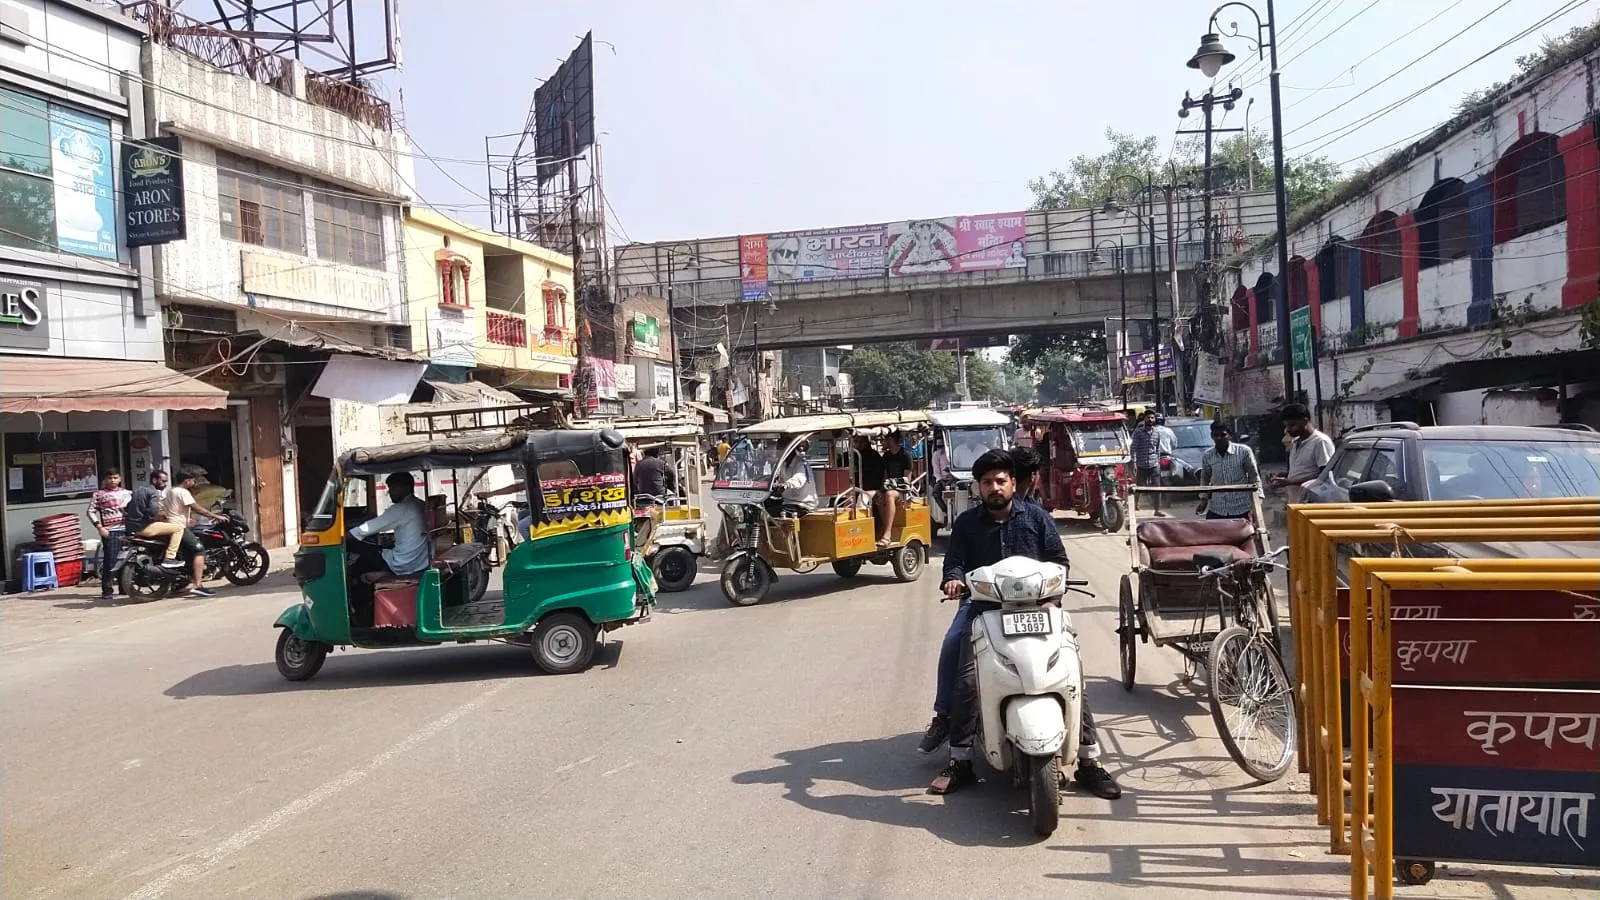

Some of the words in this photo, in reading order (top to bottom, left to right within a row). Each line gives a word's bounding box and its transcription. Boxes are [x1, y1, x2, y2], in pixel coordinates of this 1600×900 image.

[134, 155, 166, 168] ARON'S
[129, 180, 144, 188] Food
[145, 178, 174, 187] Products
[134, 188, 171, 206] ARON
[128, 207, 181, 226] STORES
[806, 231, 884, 252] भारत
[1013, 614, 1045, 624] UP25B
[1015, 623, 1045, 633] L3097
[1396, 639, 1479, 672] कृपया
[1463, 710, 1600, 756] कृपय
[1430, 786, 1597, 852] यातायात
